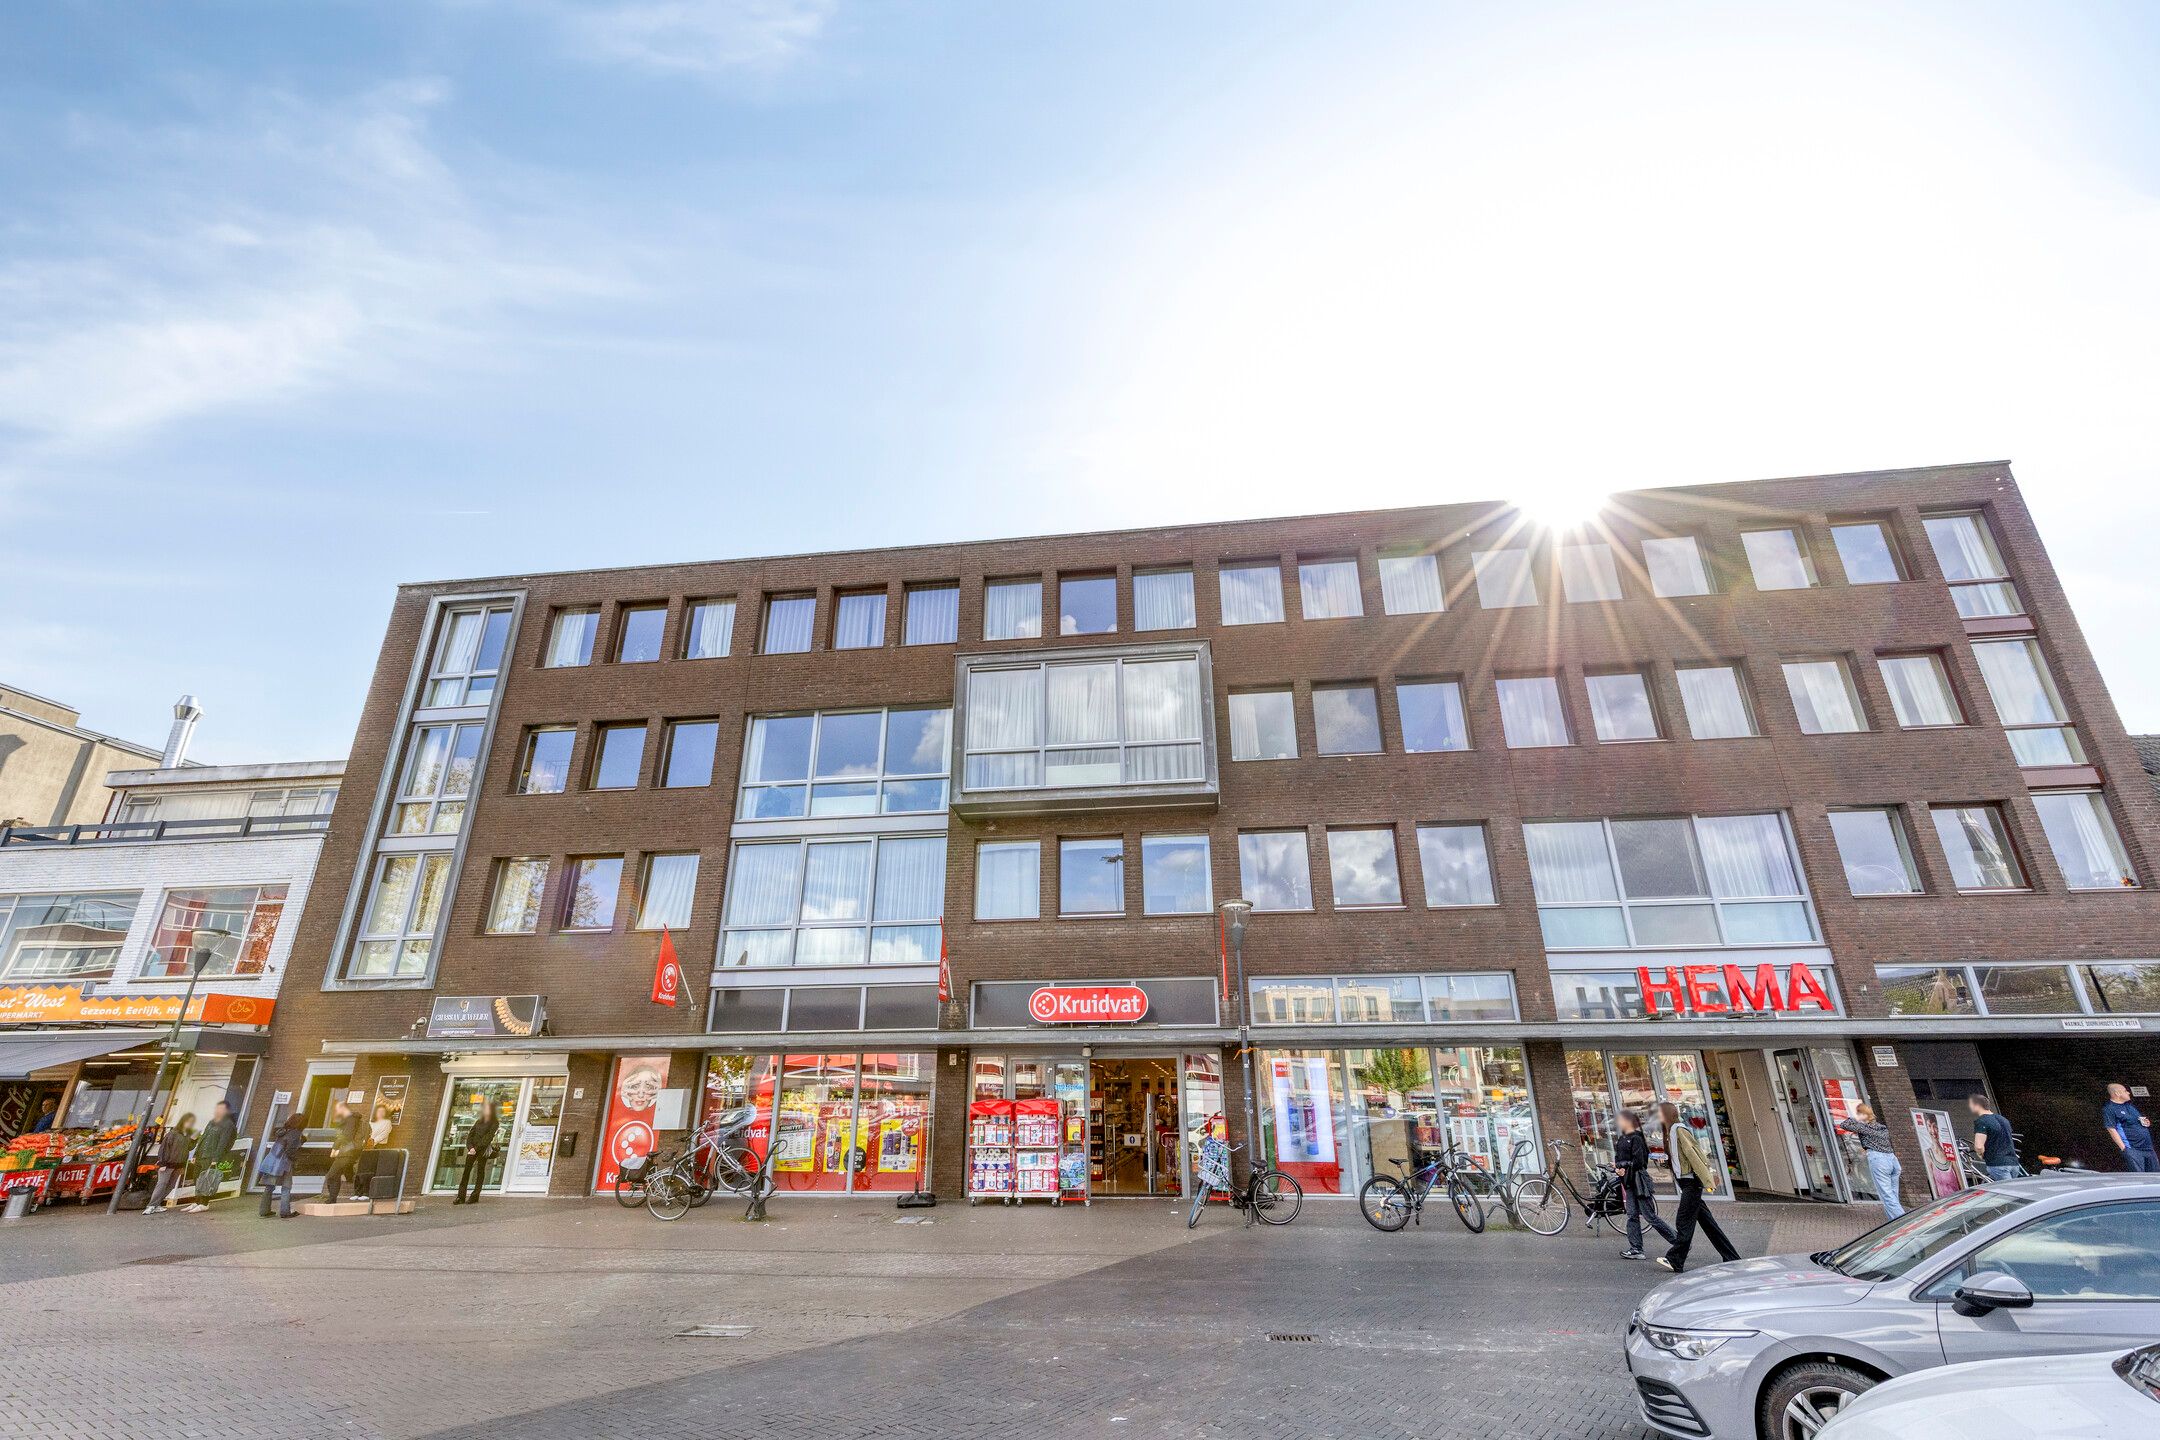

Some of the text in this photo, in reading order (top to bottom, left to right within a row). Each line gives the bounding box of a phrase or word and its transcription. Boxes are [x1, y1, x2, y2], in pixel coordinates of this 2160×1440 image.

[1637, 963, 1834, 1014] HEMA
[80, 1005, 195, 1016] Gezond, Eerlijk, Haal
[1059, 993, 1140, 1014] Kruidvat
[832, 1105, 869, 1117] ACTE!
[738, 1125, 767, 1138] idvat
[55, 1168, 87, 1182] ACTIE
[3, 1174, 45, 1192] ACTIE
